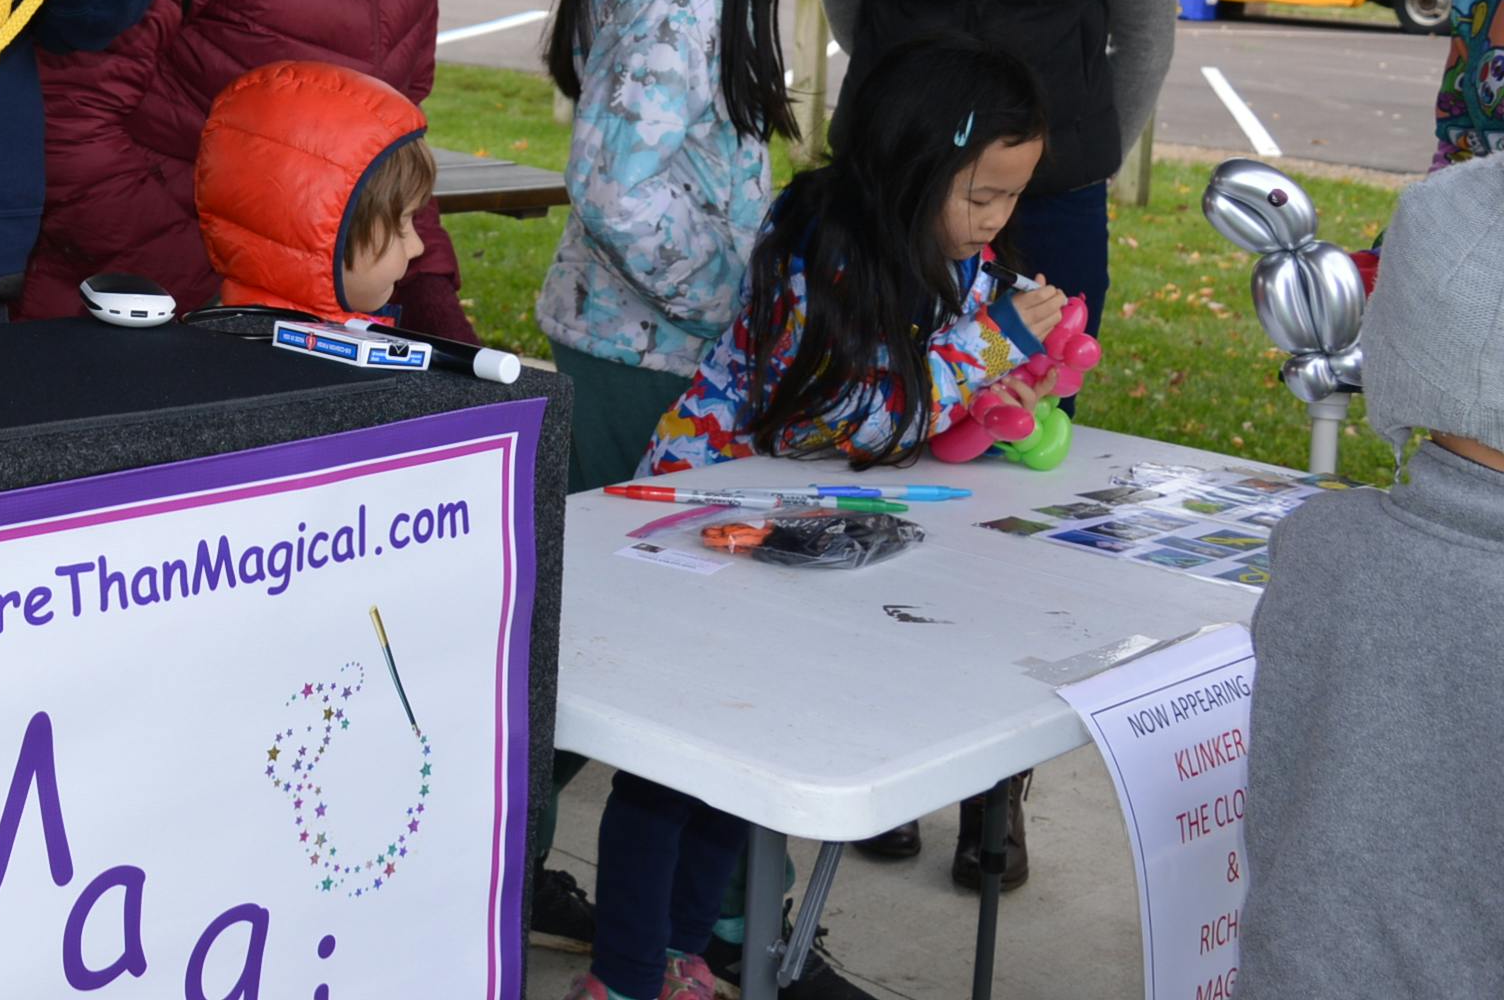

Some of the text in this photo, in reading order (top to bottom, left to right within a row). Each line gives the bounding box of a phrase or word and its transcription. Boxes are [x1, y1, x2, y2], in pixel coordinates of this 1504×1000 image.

[1127, 674, 1252, 738] NOW APPEARING
[1174, 728, 1247, 782] KLINKER
[1176, 787, 1248, 844] THE CLO
[1226, 851, 1240, 883] &
